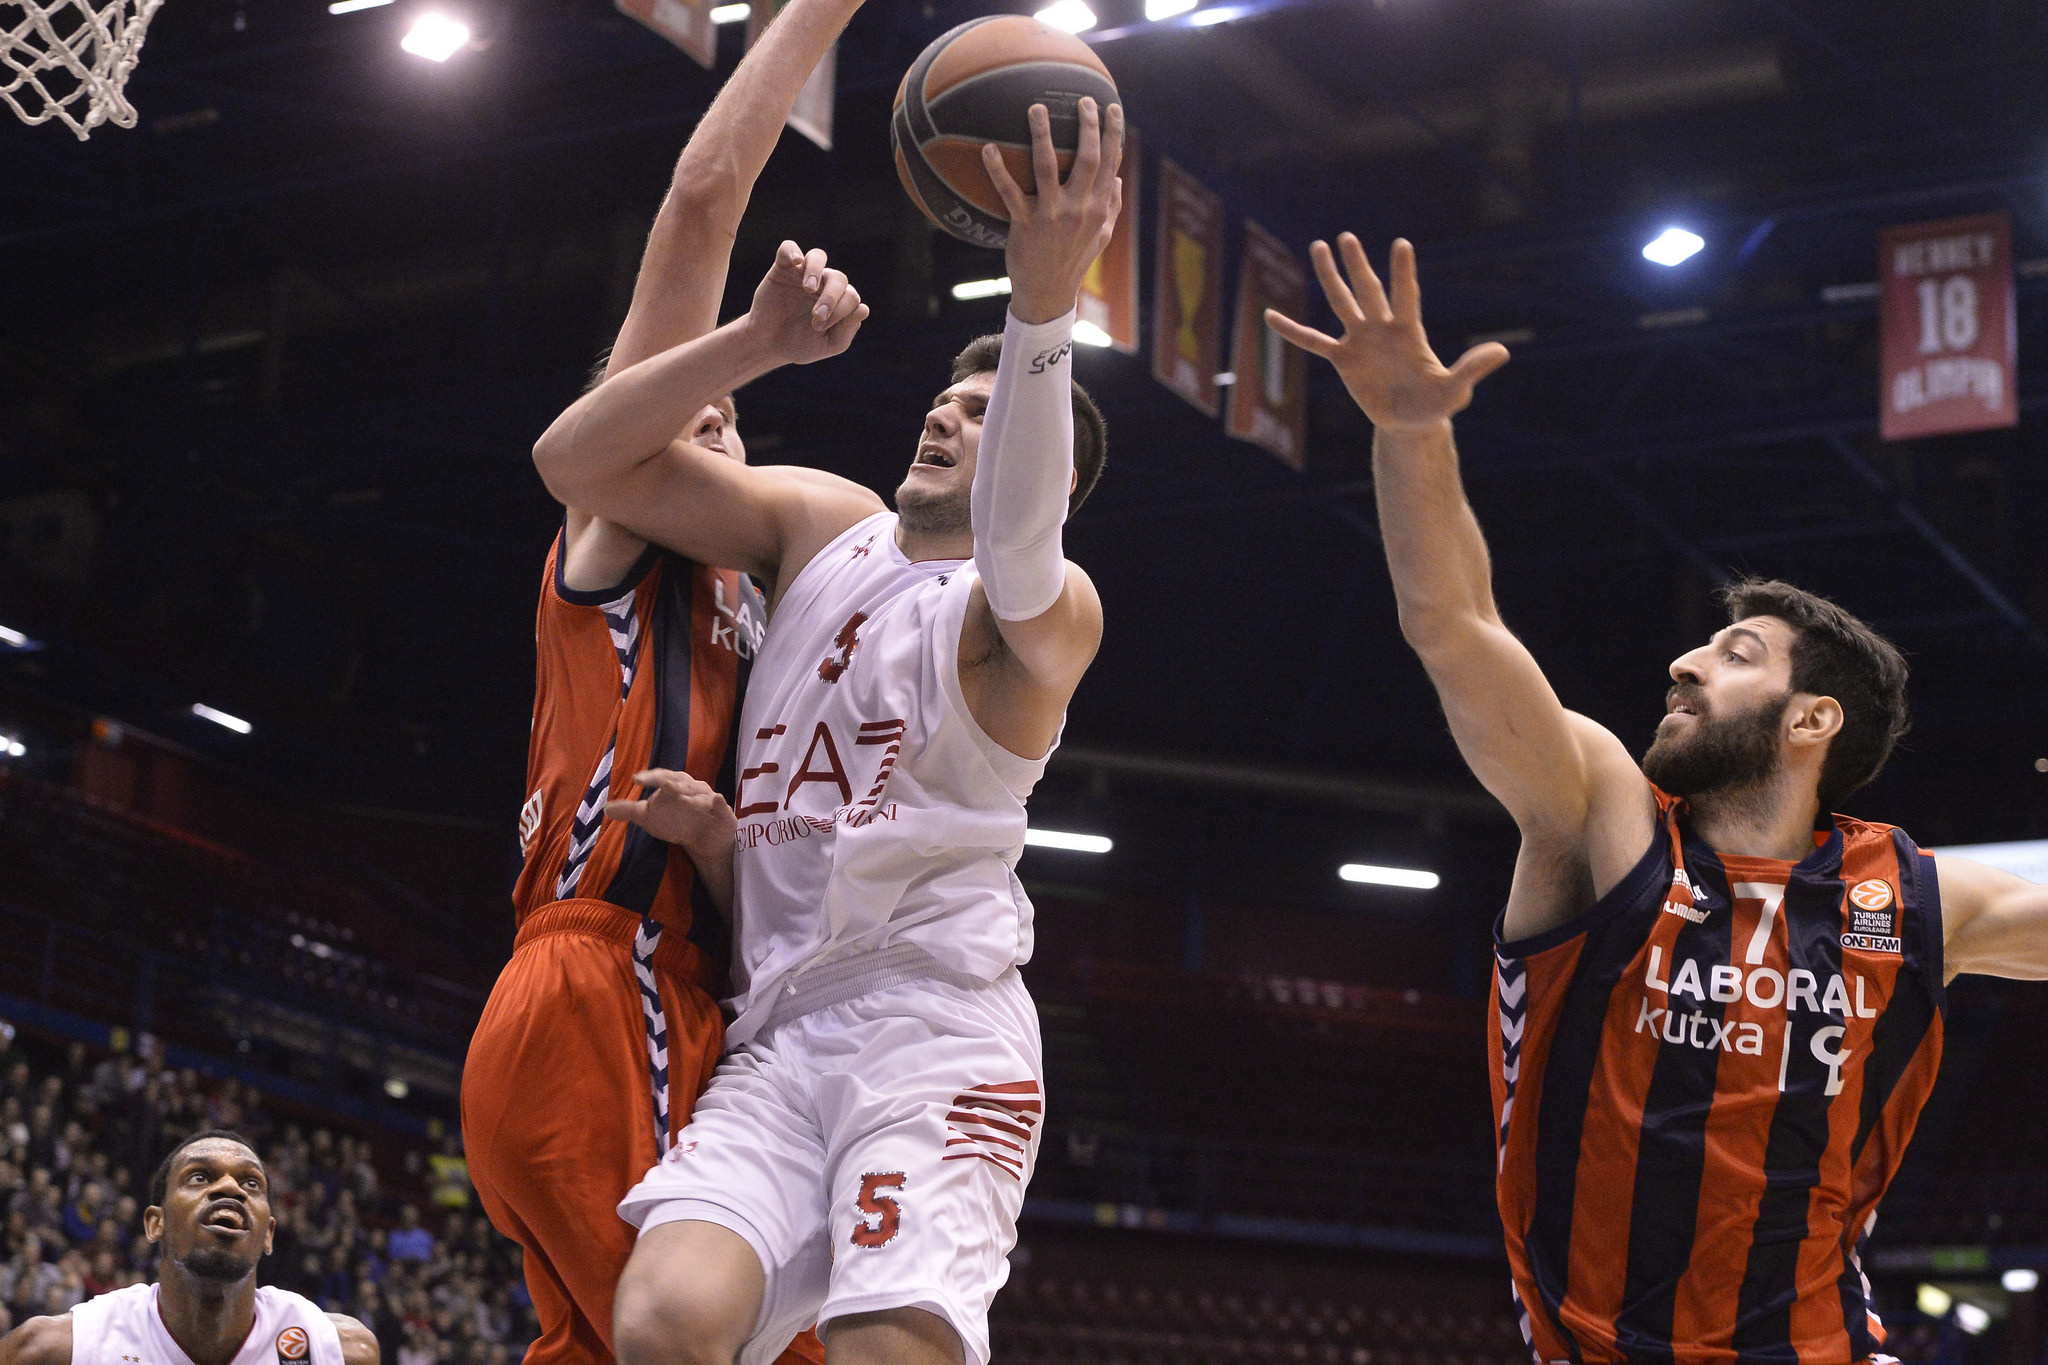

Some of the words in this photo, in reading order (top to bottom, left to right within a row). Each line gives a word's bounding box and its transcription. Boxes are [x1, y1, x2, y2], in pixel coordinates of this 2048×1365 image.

[1917, 275, 1977, 355] 18
[735, 718, 907, 819] EA7
[1663, 900, 1711, 924] ummel
[1733, 882, 1785, 965] 7
[1853, 911, 1892, 921] TURKISH
[1853, 919, 1891, 928] AIRLINES
[1645, 945, 1877, 1019] LABORAL
[850, 1171, 907, 1250] 5
